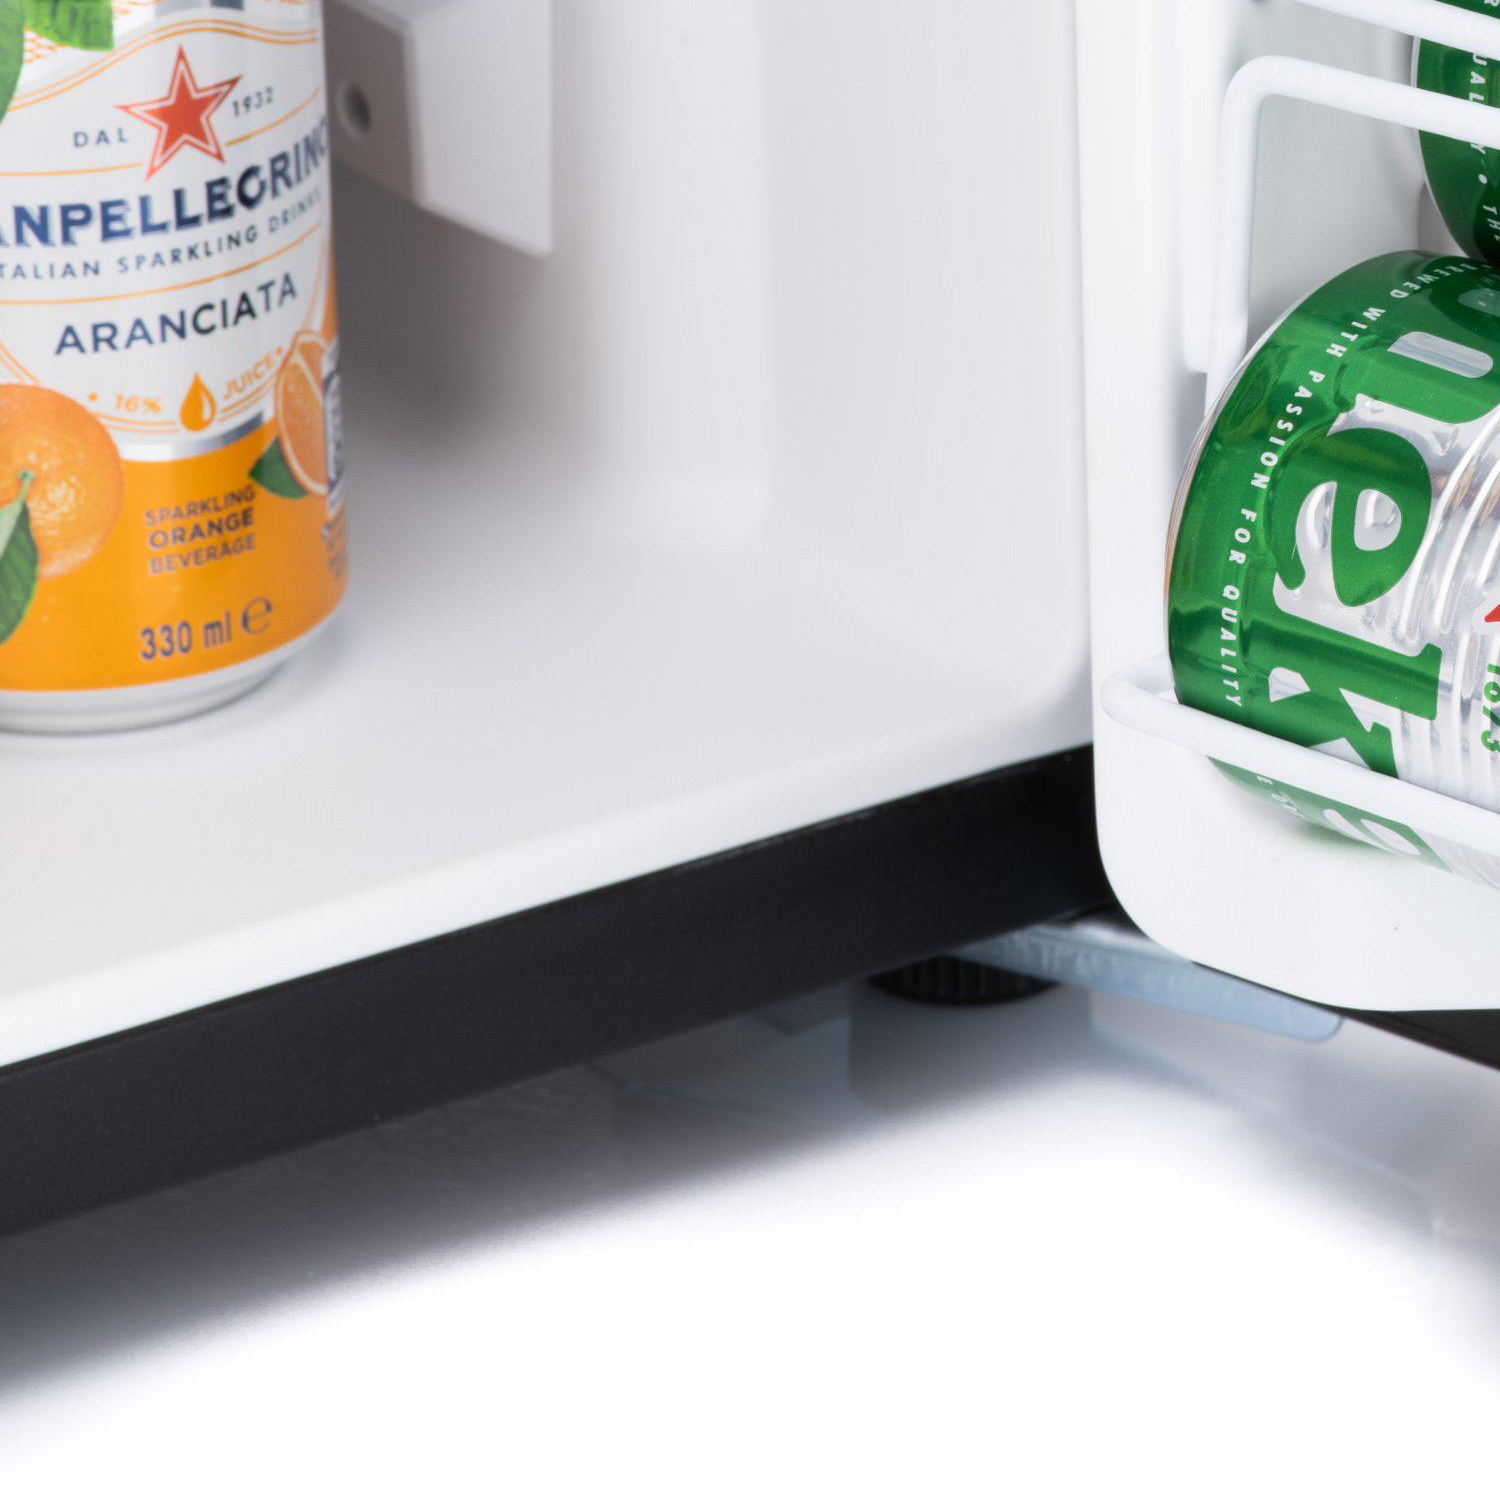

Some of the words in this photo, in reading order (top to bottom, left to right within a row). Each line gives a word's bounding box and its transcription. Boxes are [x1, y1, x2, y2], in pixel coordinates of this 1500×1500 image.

[232, 87, 274, 118] 1932
[73, 128, 129, 149] DAL
[117, 225, 259, 273] SPARKLING
[55, 272, 298, 355] ARANCIATA
[1326, 307, 1386, 358] WITH
[115, 393, 163, 414] 16%
[1250, 370, 1326, 490] PASSION
[144, 485, 256, 527] SPARKLING
[149, 507, 256, 549] ORANGE
[149, 533, 256, 575] BEVERAGE
[1229, 508, 1256, 565] FOR
[139, 621, 193, 660] 330
[203, 611, 232, 648] ml
[1220, 584, 1243, 707] QUALITY
